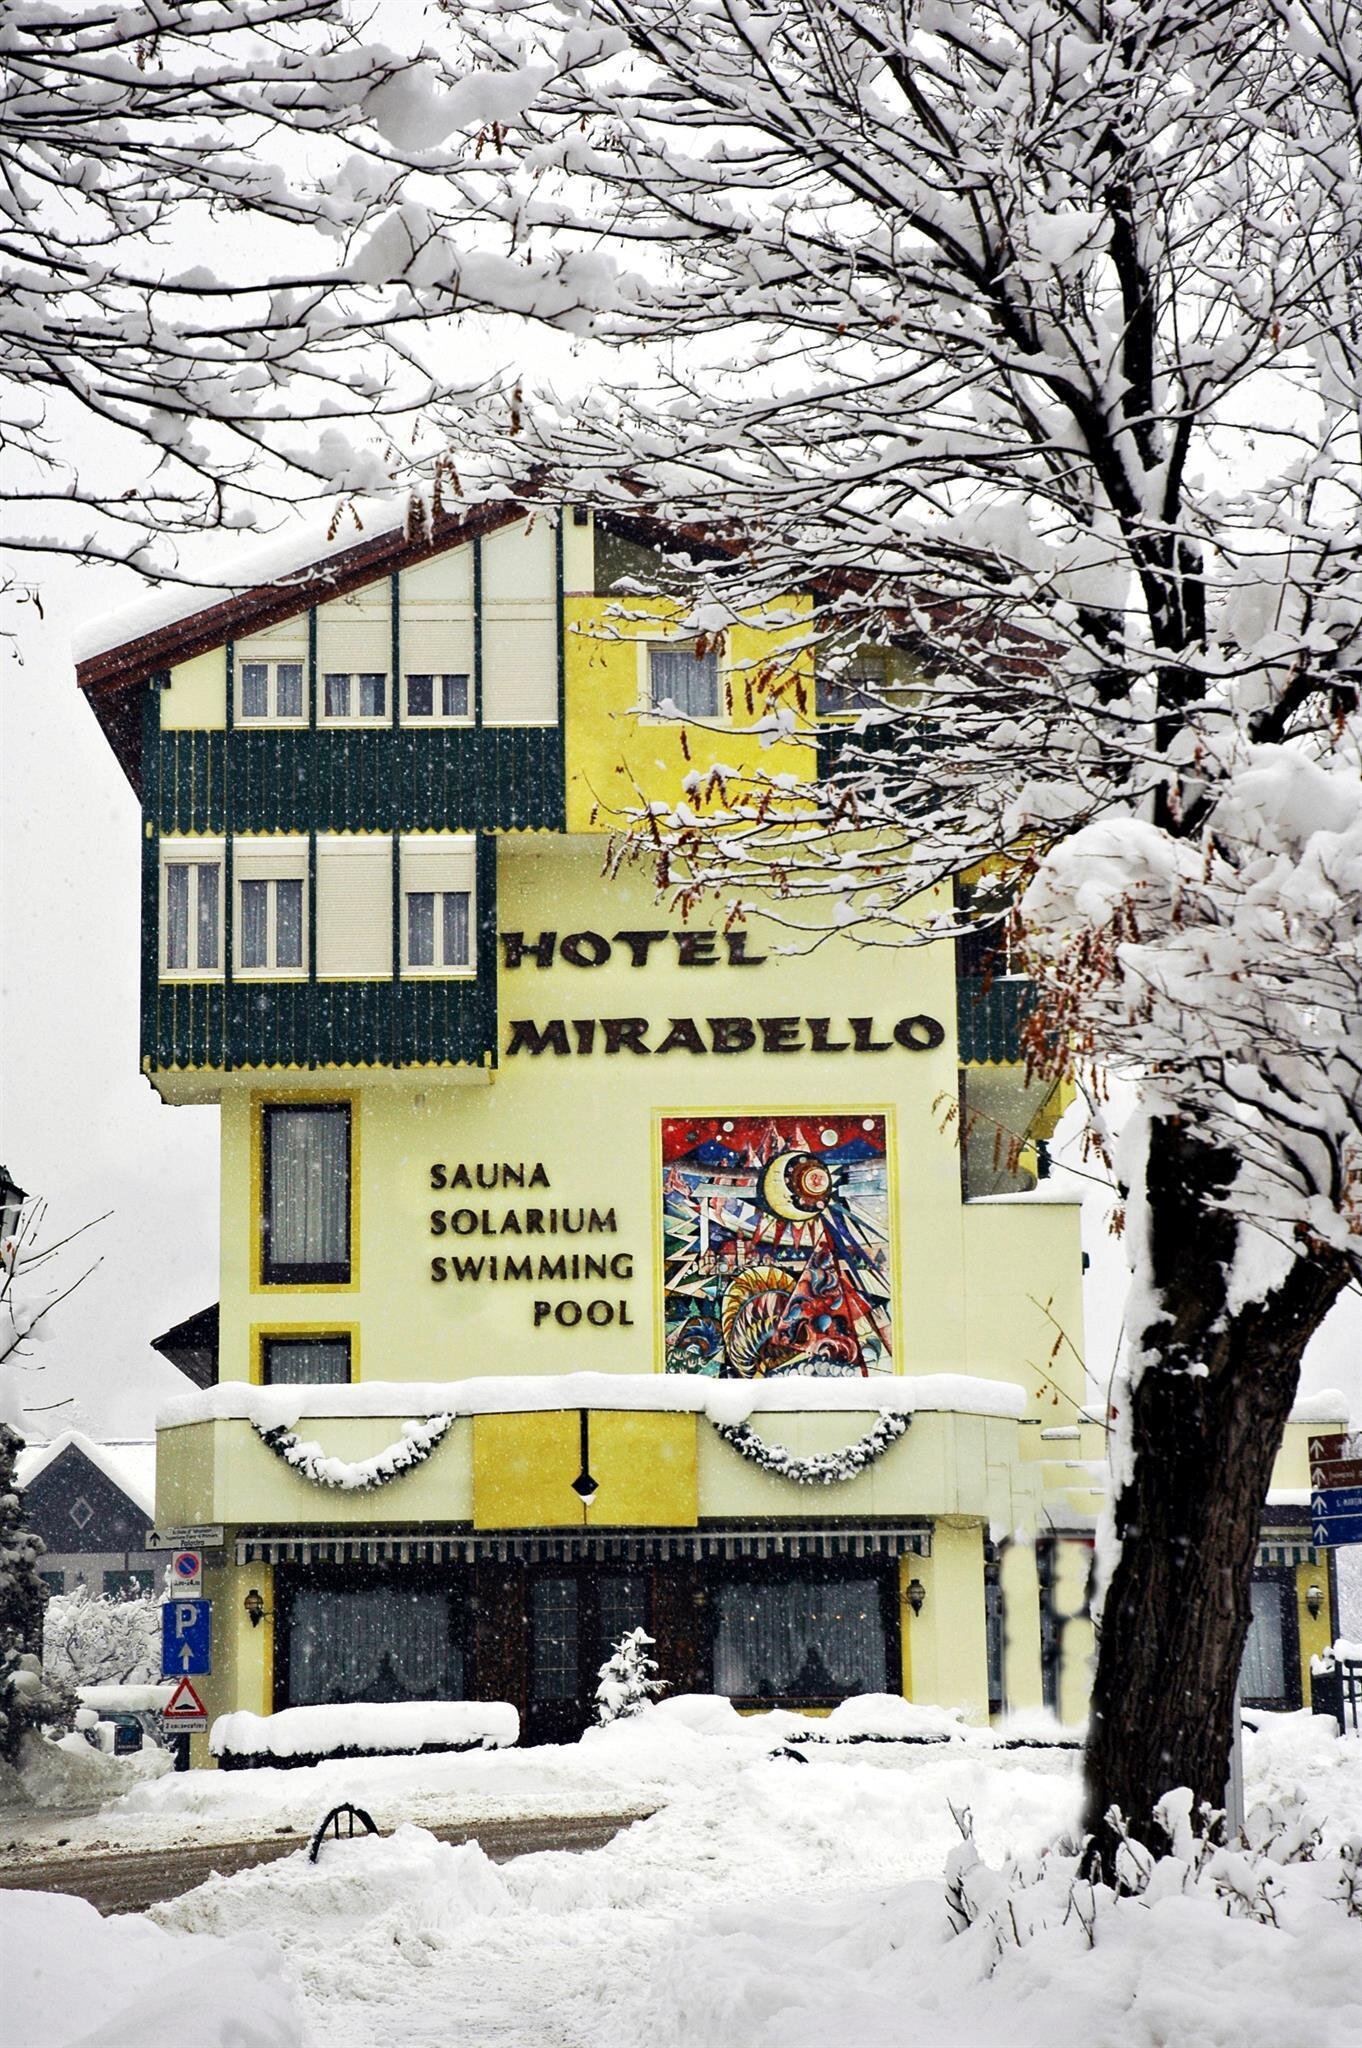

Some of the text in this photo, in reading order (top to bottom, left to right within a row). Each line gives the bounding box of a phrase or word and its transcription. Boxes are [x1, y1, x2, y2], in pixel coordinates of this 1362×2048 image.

[499, 930, 768, 967] HOTEL
[506, 1014, 945, 1056] MIRABELLO
[430, 1163, 551, 1189] SAUNA
[430, 1208, 618, 1236] SOLARIUM
[431, 1253, 634, 1282] SWIMMING
[534, 1300, 634, 1327] POOL
[175, 1604, 198, 1639] P
